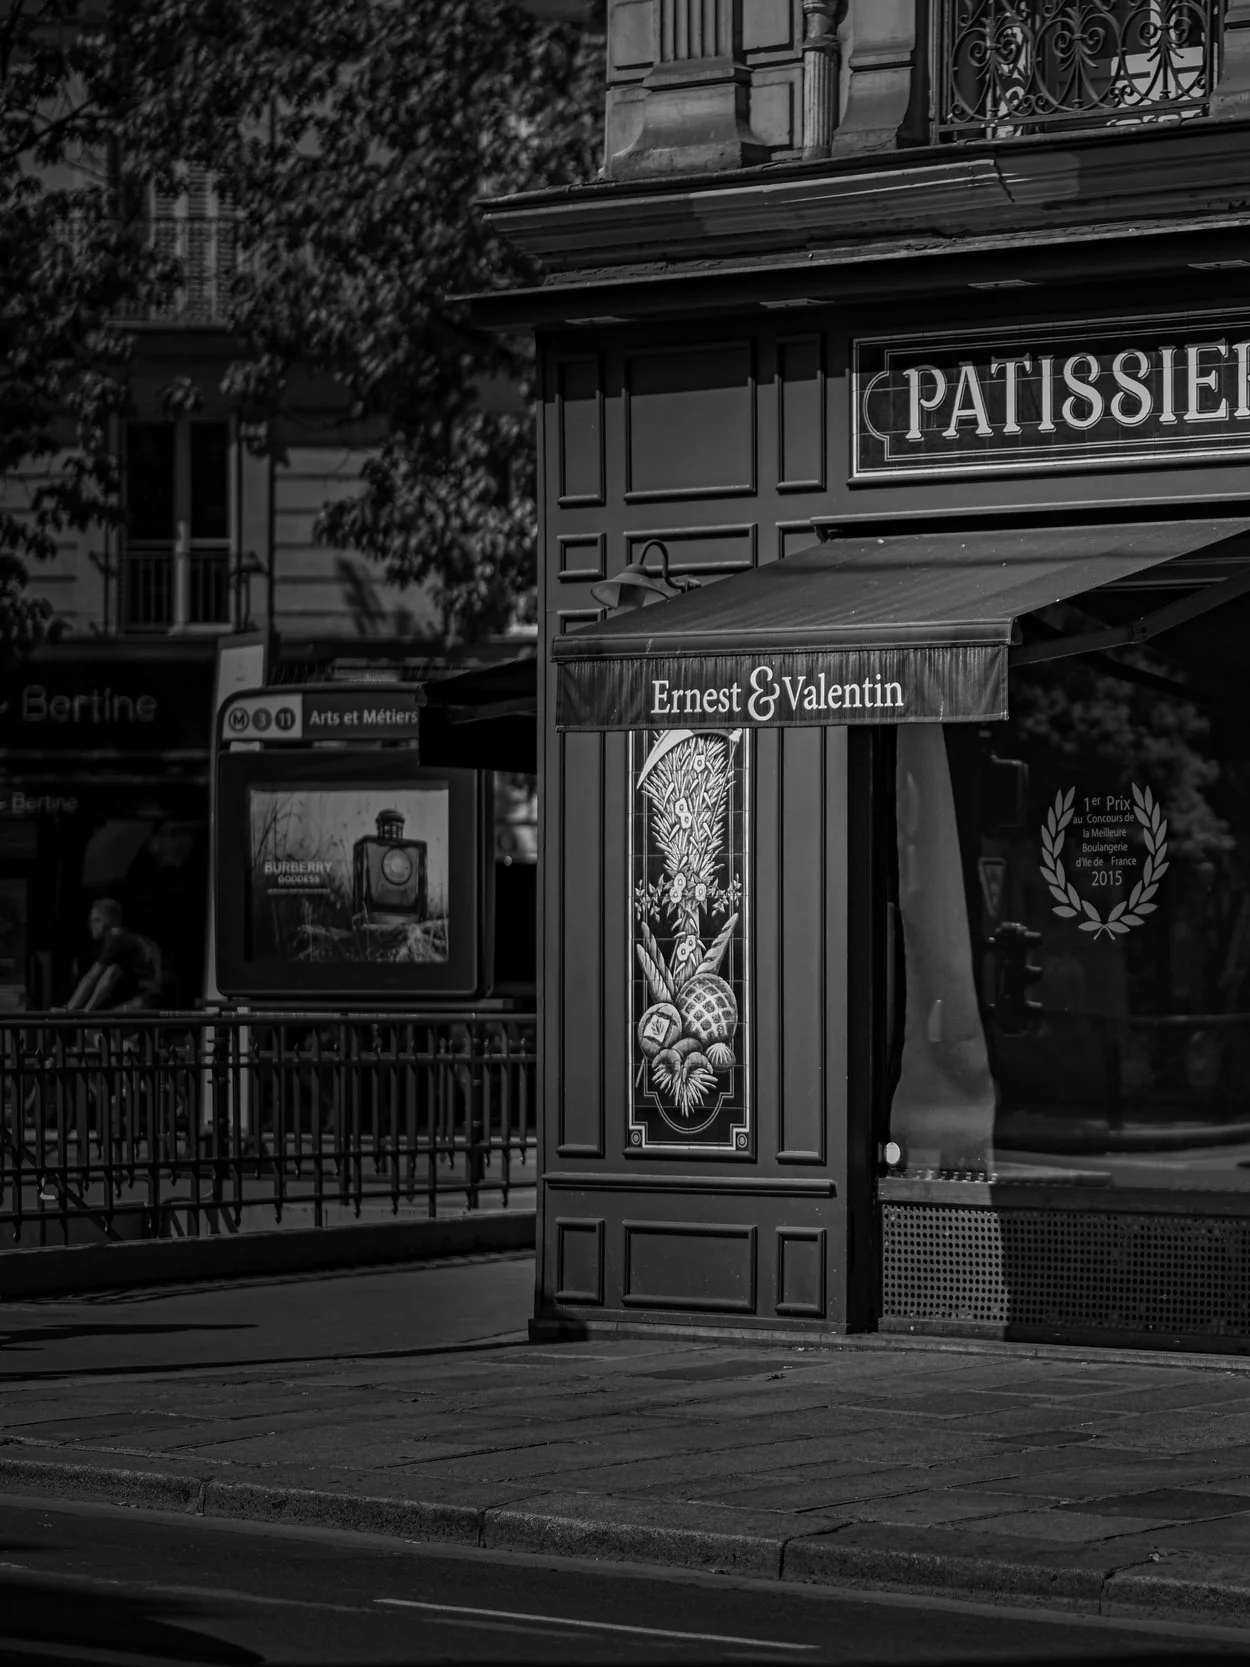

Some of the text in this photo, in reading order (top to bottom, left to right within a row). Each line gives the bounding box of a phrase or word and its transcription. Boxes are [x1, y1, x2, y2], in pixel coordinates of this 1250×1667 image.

[650, 665, 904, 721] Ernest & Valentin
[21, 684, 158, 724] Bertine
[309, 709, 340, 726] Arts
[343, 710, 358, 725] et
[363, 708, 418, 725] Métiers
[11, 791, 79, 815] Bertine
[1084, 795, 1131, 812] 1er Prix
[1073, 812, 1135, 824] au Concours de
[1082, 827, 1127, 838] la Meilleure
[1082, 842, 1128, 854] Boulangerie
[264, 861, 333, 875] BURBERRY
[1093, 856, 1104, 866] de
[1111, 856, 1137, 866] France
[277, 874, 320, 885] GODDESS
[1091, 870, 1123, 886] 2015
